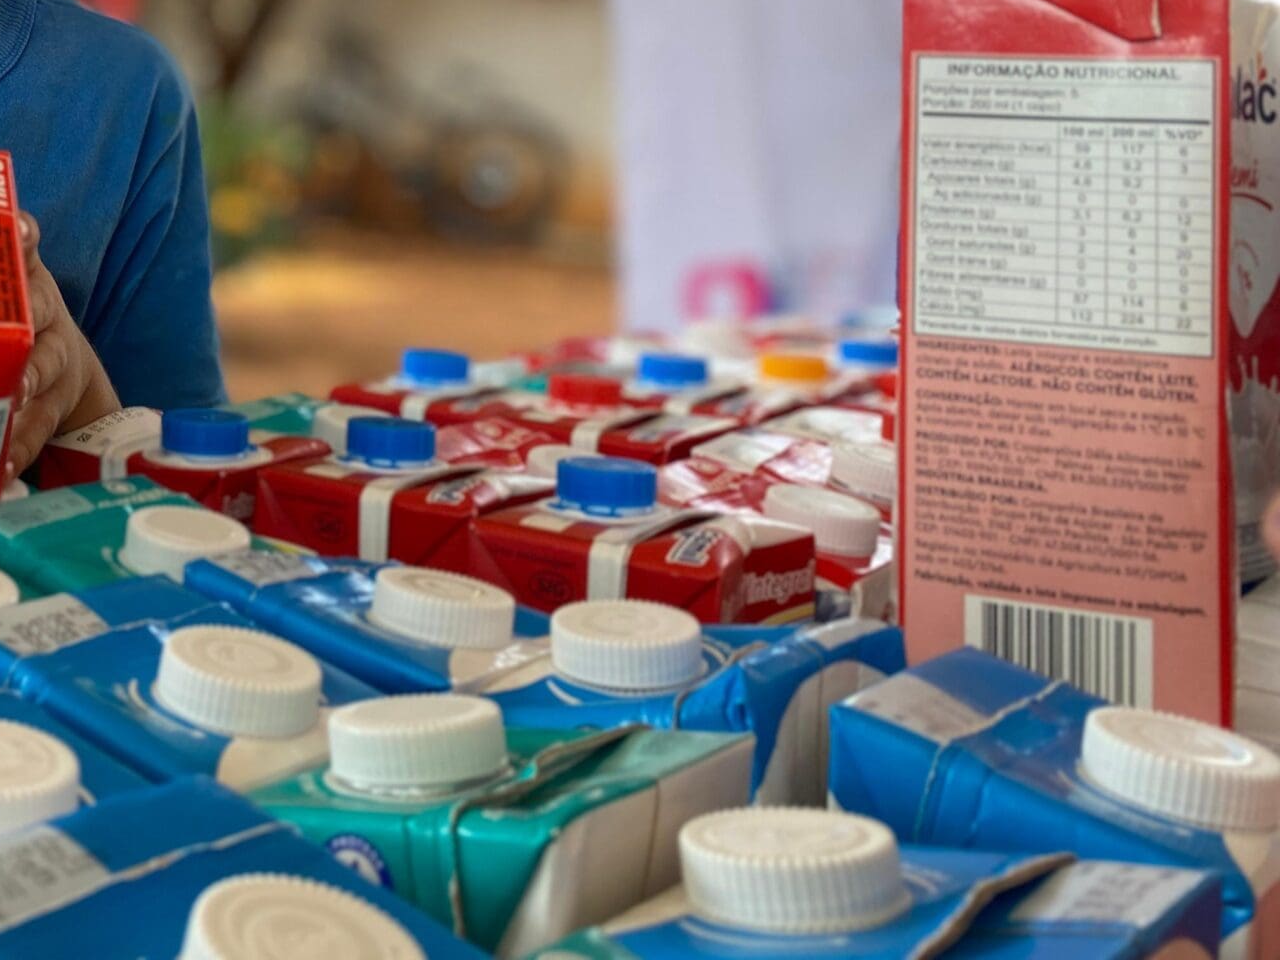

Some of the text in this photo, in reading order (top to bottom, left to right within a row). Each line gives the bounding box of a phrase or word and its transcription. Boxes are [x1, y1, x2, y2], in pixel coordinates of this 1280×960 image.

[947, 63, 1182, 80] INFORMAÇÃO NUTRICIONAL
[1231, 64, 1276, 123] lac
[916, 340, 1001, 355] INGREDIENTES:
[916, 366, 971, 382] CONTÉM
[1042, 376, 1071, 391] NÃO
[1075, 381, 1135, 396] CONTÉM
[1010, 360, 1088, 378] ALÉRGICOS:
[1094, 368, 1154, 383] CONTÉM
